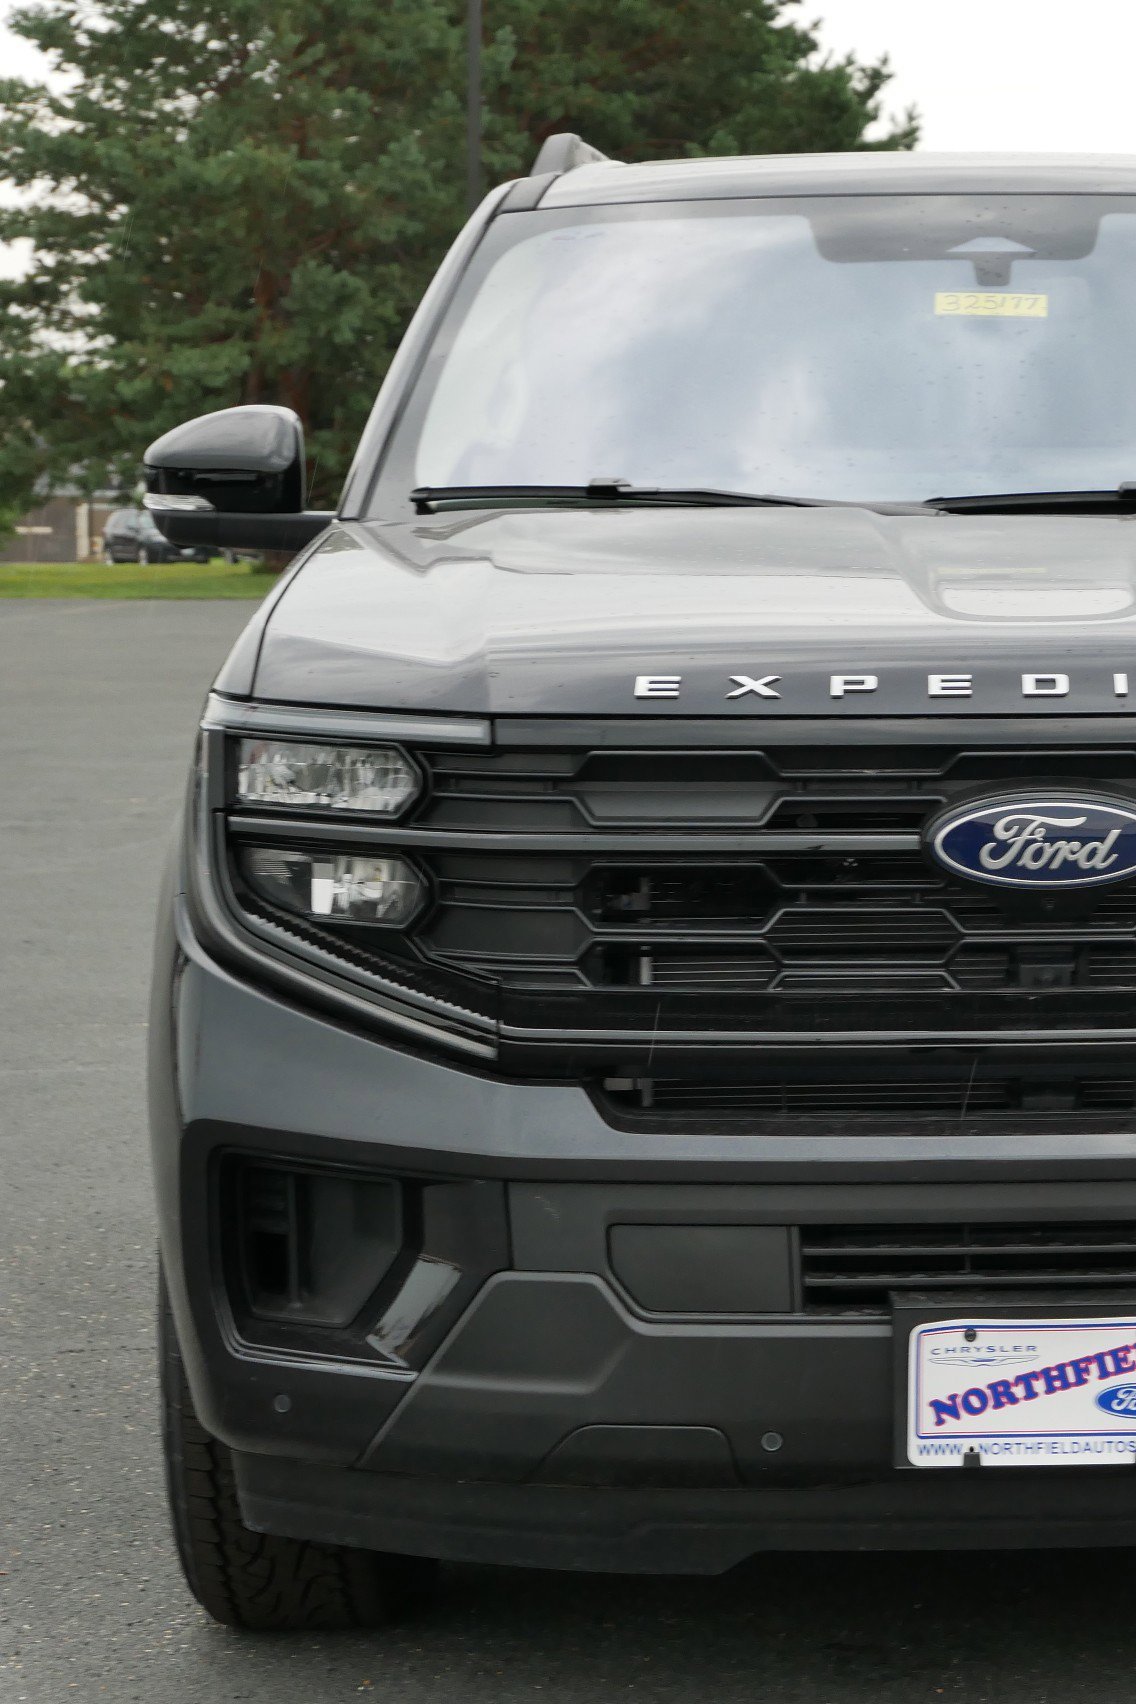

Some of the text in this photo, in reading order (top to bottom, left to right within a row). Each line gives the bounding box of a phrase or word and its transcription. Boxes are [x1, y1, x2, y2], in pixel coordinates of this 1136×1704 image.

[942, 294, 1040, 312] 325177
[979, 814, 1122, 870] Ford
[930, 1345, 1038, 1356] CHRYSLER
